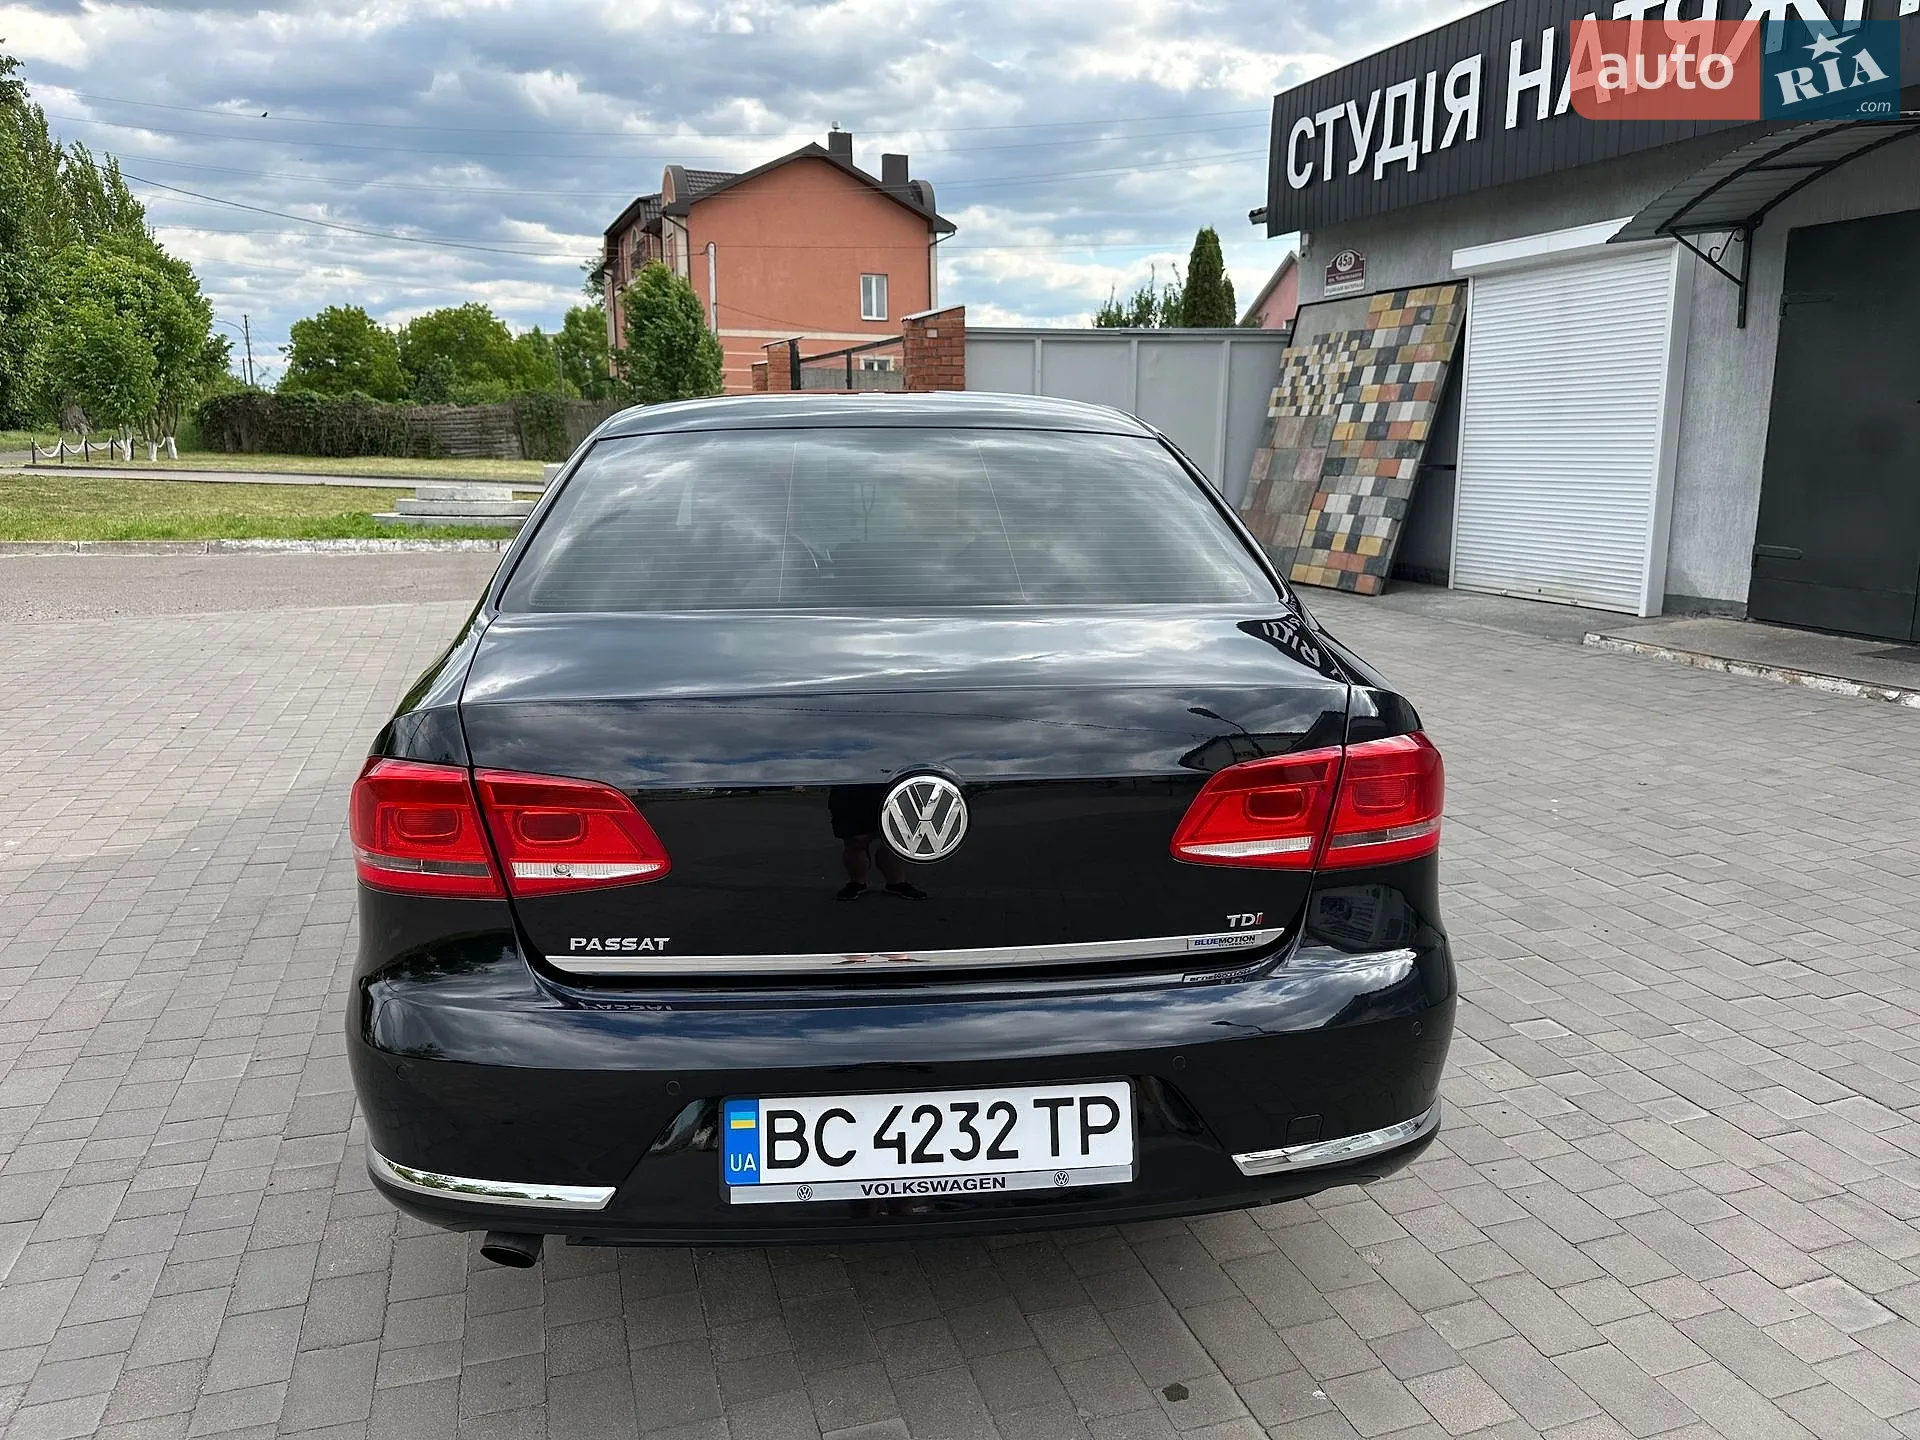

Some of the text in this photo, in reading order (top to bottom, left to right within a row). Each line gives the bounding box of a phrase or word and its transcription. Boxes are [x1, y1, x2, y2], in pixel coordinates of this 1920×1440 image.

[1287, 0, 1920, 189] СТУДІЯ НАТЯЖ
[569, 937, 671, 951] PASSAT
[1194, 935, 1256, 946] BLUEMOTION
[766, 1096, 1121, 1169] BC 4232 TP
[730, 1152, 757, 1172] UA
[860, 1177, 1006, 1196] VOLKSWAGEN
